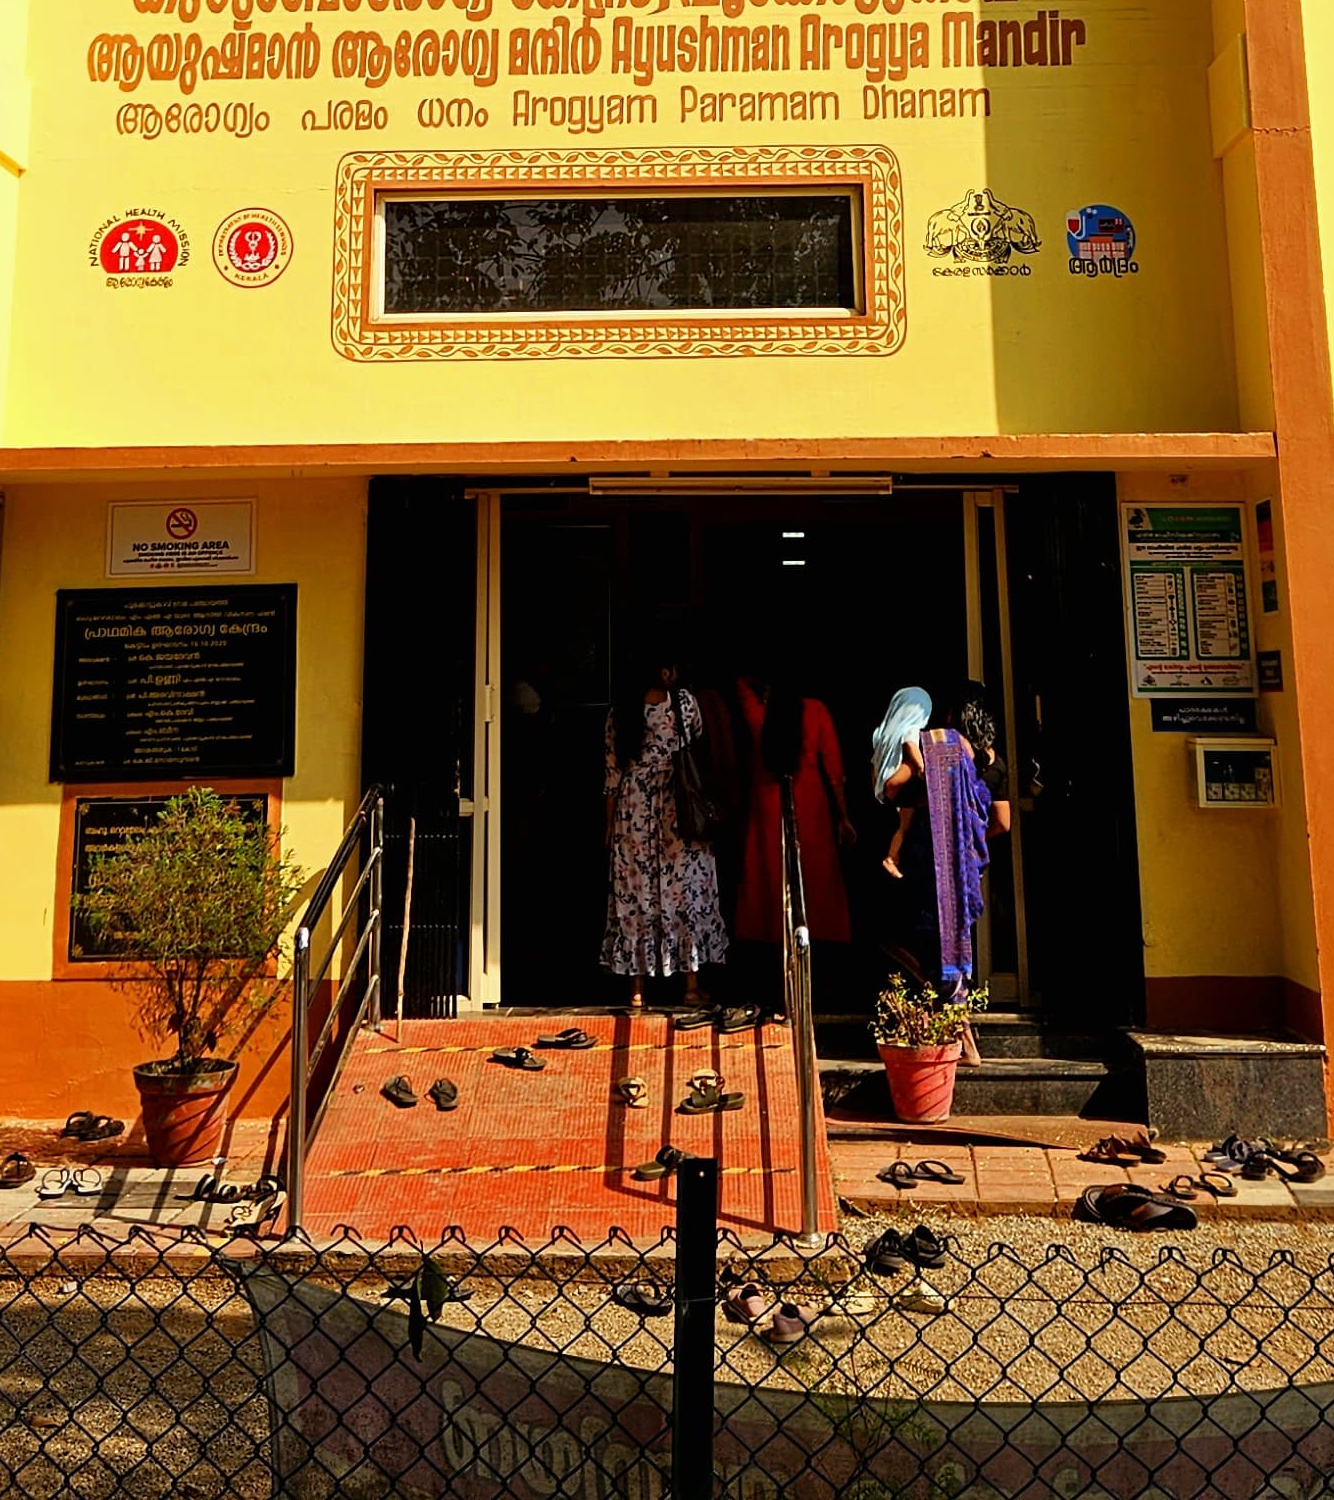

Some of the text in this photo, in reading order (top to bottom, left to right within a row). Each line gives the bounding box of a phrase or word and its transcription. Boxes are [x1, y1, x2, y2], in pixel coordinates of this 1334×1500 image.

[88, 20, 320, 94] ആയുഷ്മാൻ
[332, 28, 498, 87] ആരോഗ്യ
[612, 15, 790, 86] Ayushman
[800, 13, 929, 82] Arogya
[942, 9, 1086, 68] Mandir
[116, 83, 991, 140] ആരോഗ്യം പരമം ധനം Arogyam Paramam Dhanam
[88, 208, 191, 267] NATIONAL HEALTH MISSION
[235, 273, 269, 282] KERALA
[133, 540, 230, 552] NO SMOKING AREA
[84, 623, 268, 640] പ്രാഥമിക ആരോഗ്യ കേന്ദ്രം
